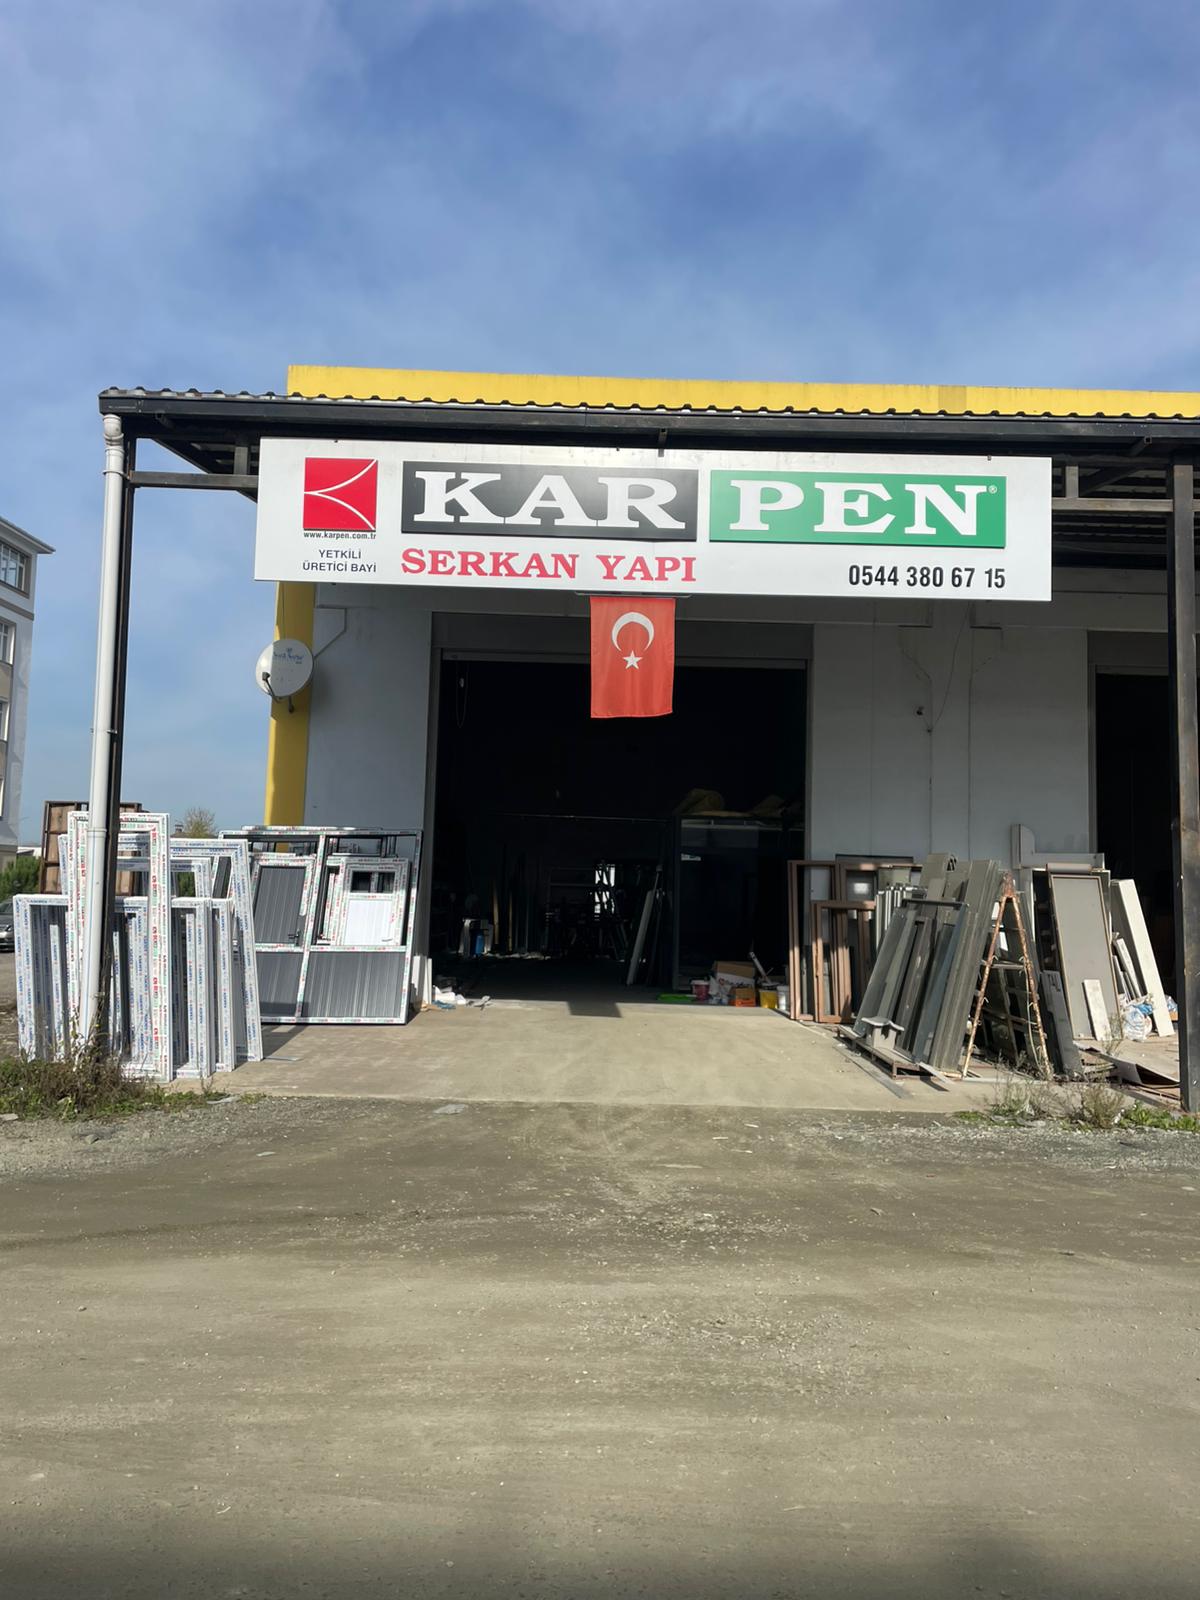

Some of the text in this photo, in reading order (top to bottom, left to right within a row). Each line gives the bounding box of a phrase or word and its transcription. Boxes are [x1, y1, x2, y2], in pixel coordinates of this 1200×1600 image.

[413, 471, 686, 530] KAR
[303, 531, 376, 540] www.karpen.com.tr
[318, 548, 361, 559] YETKİLİ
[302, 560, 377, 573] ÜRETİCİ BAYİ
[401, 548, 696, 582] SERKAN YAPI
[848, 564, 1006, 589] 0544 380 67 15
